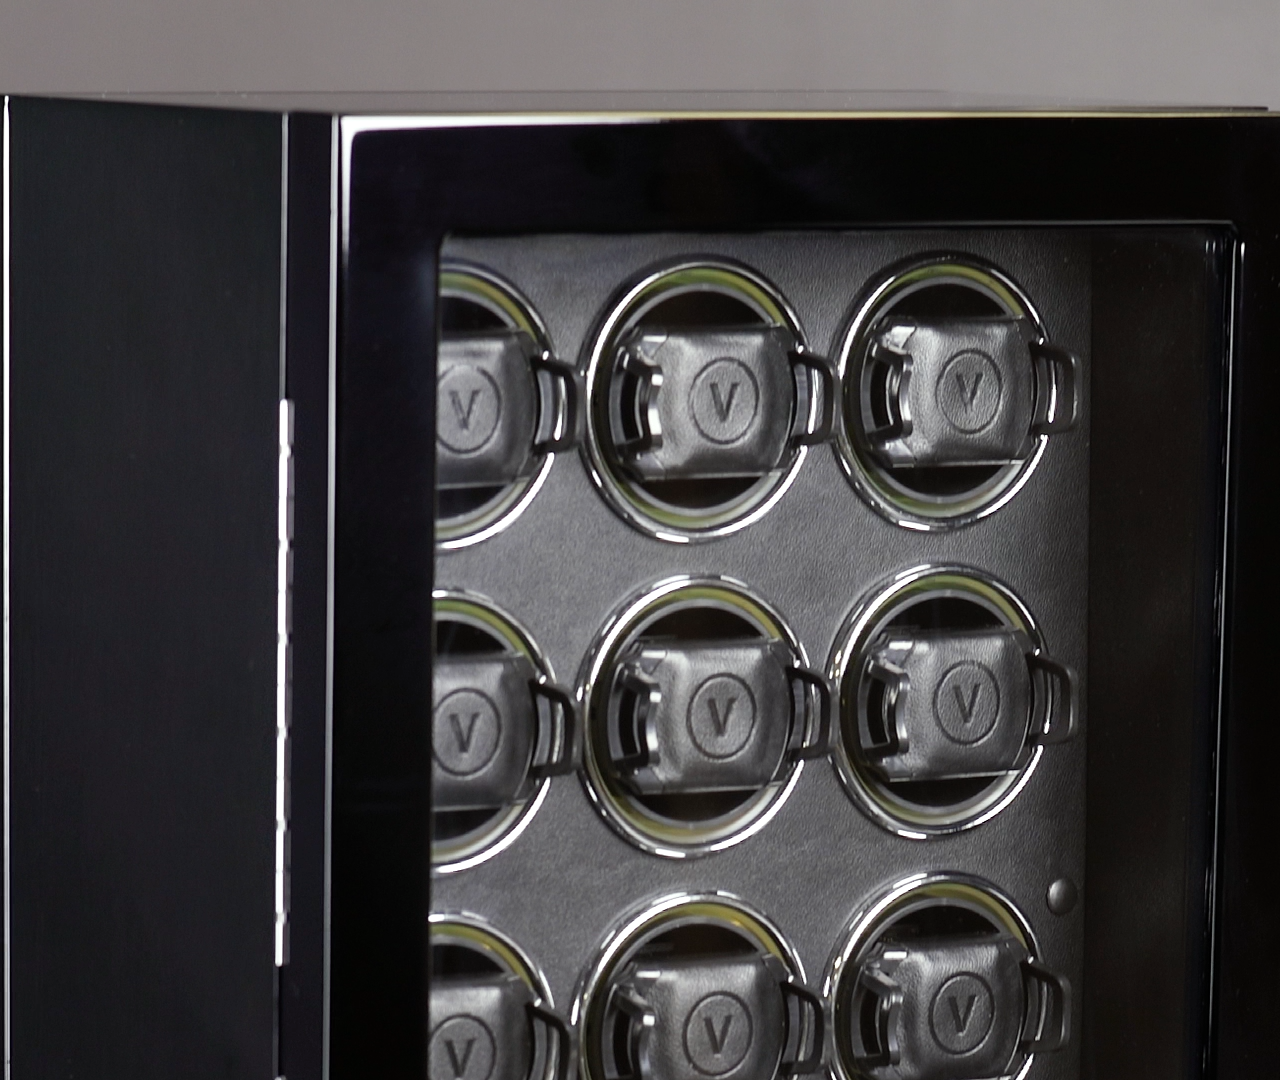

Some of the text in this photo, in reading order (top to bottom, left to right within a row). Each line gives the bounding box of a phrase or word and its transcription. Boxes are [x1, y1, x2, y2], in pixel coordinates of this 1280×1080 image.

[448, 388, 481, 429] V
[710, 380, 739, 425] V
[956, 372, 984, 412] V
[708, 697, 738, 737] V
[954, 684, 981, 725] V
[449, 711, 480, 753] V
[704, 1014, 734, 1057] V
[949, 995, 978, 1036] V
[445, 1037, 476, 1080] V
